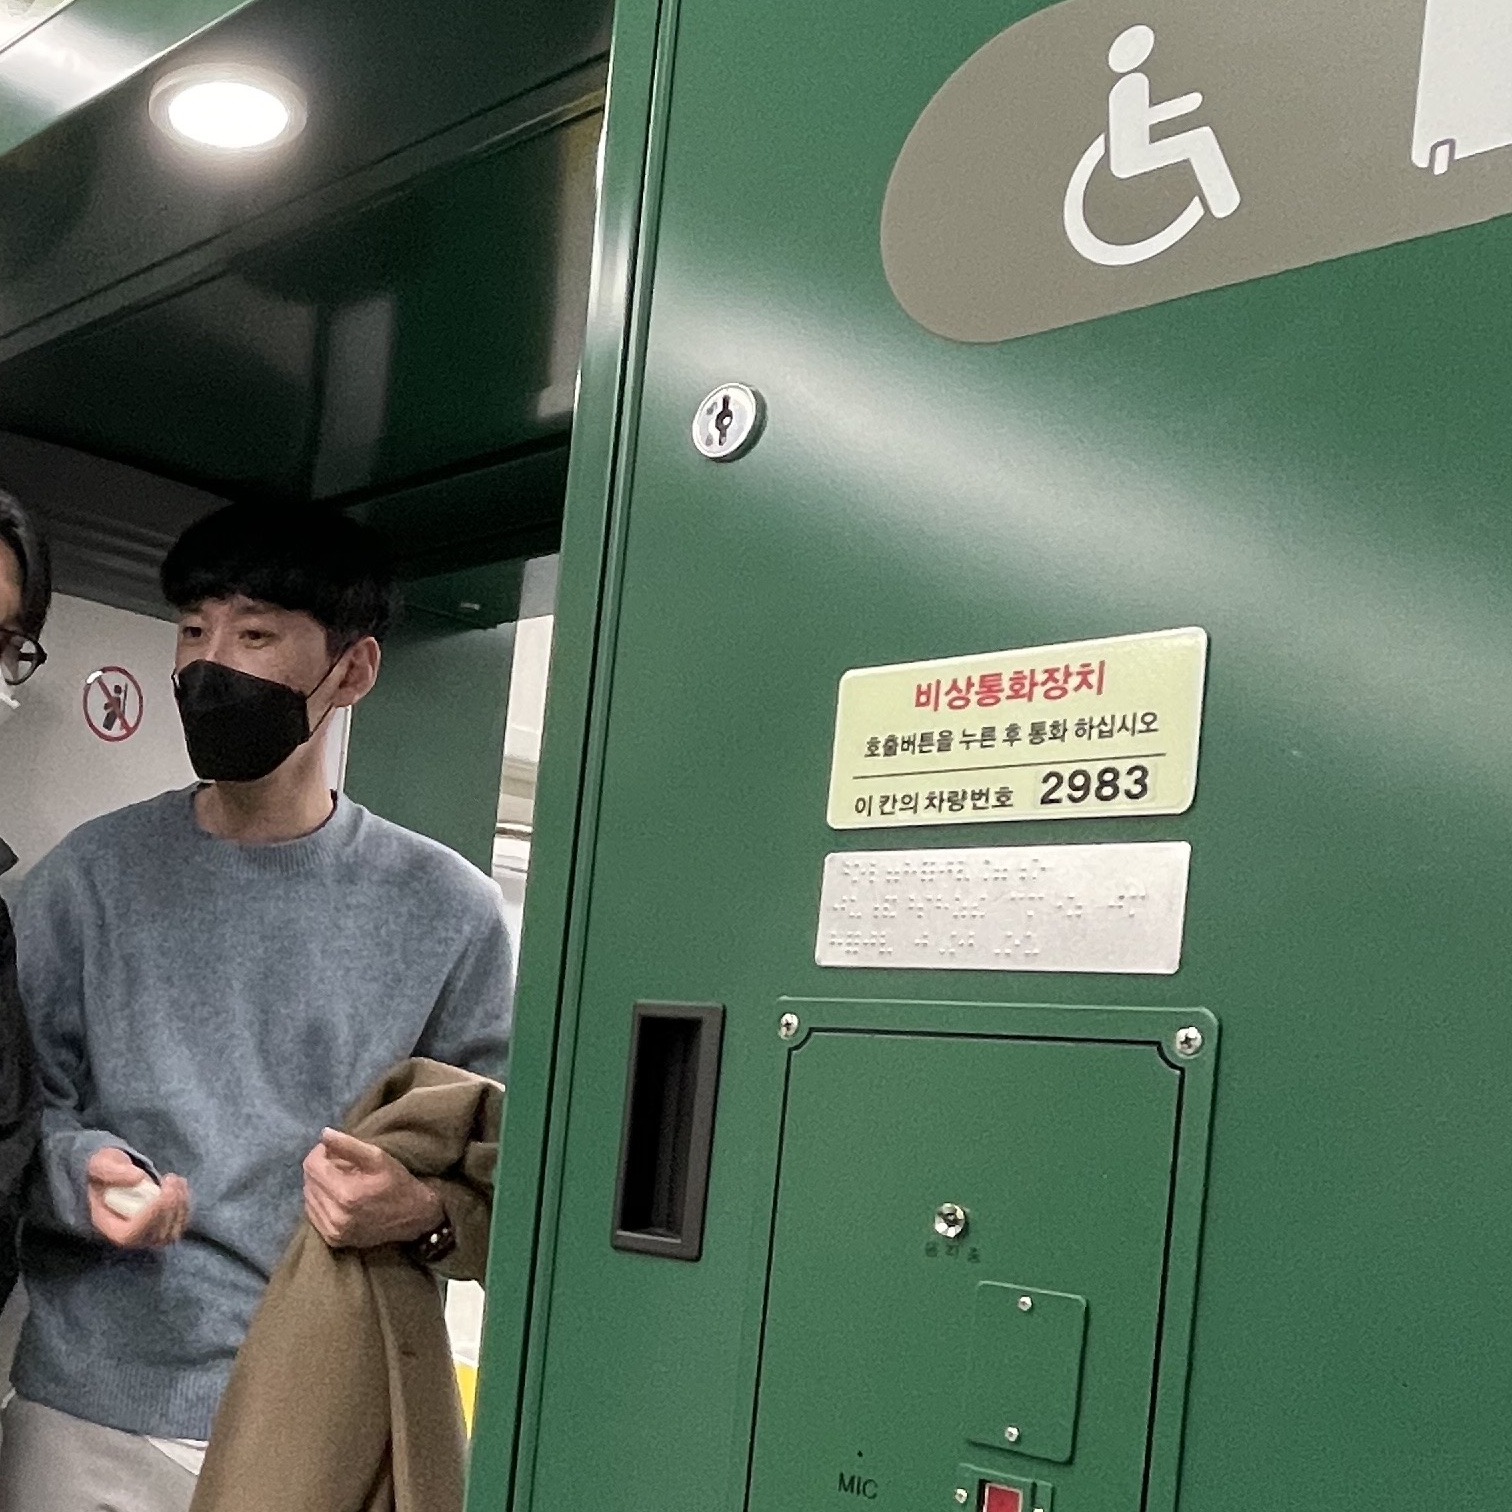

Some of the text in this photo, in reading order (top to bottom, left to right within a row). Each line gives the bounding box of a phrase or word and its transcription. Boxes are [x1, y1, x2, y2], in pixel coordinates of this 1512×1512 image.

[914, 660, 1106, 712] 비상통화장치
[864, 711, 1159, 758] 호출버튼을 누른 후 통화 하십시오
[854, 764, 1149, 817] 이 칸의 차량번호 2983
[838, 1471, 878, 1500] MIC
